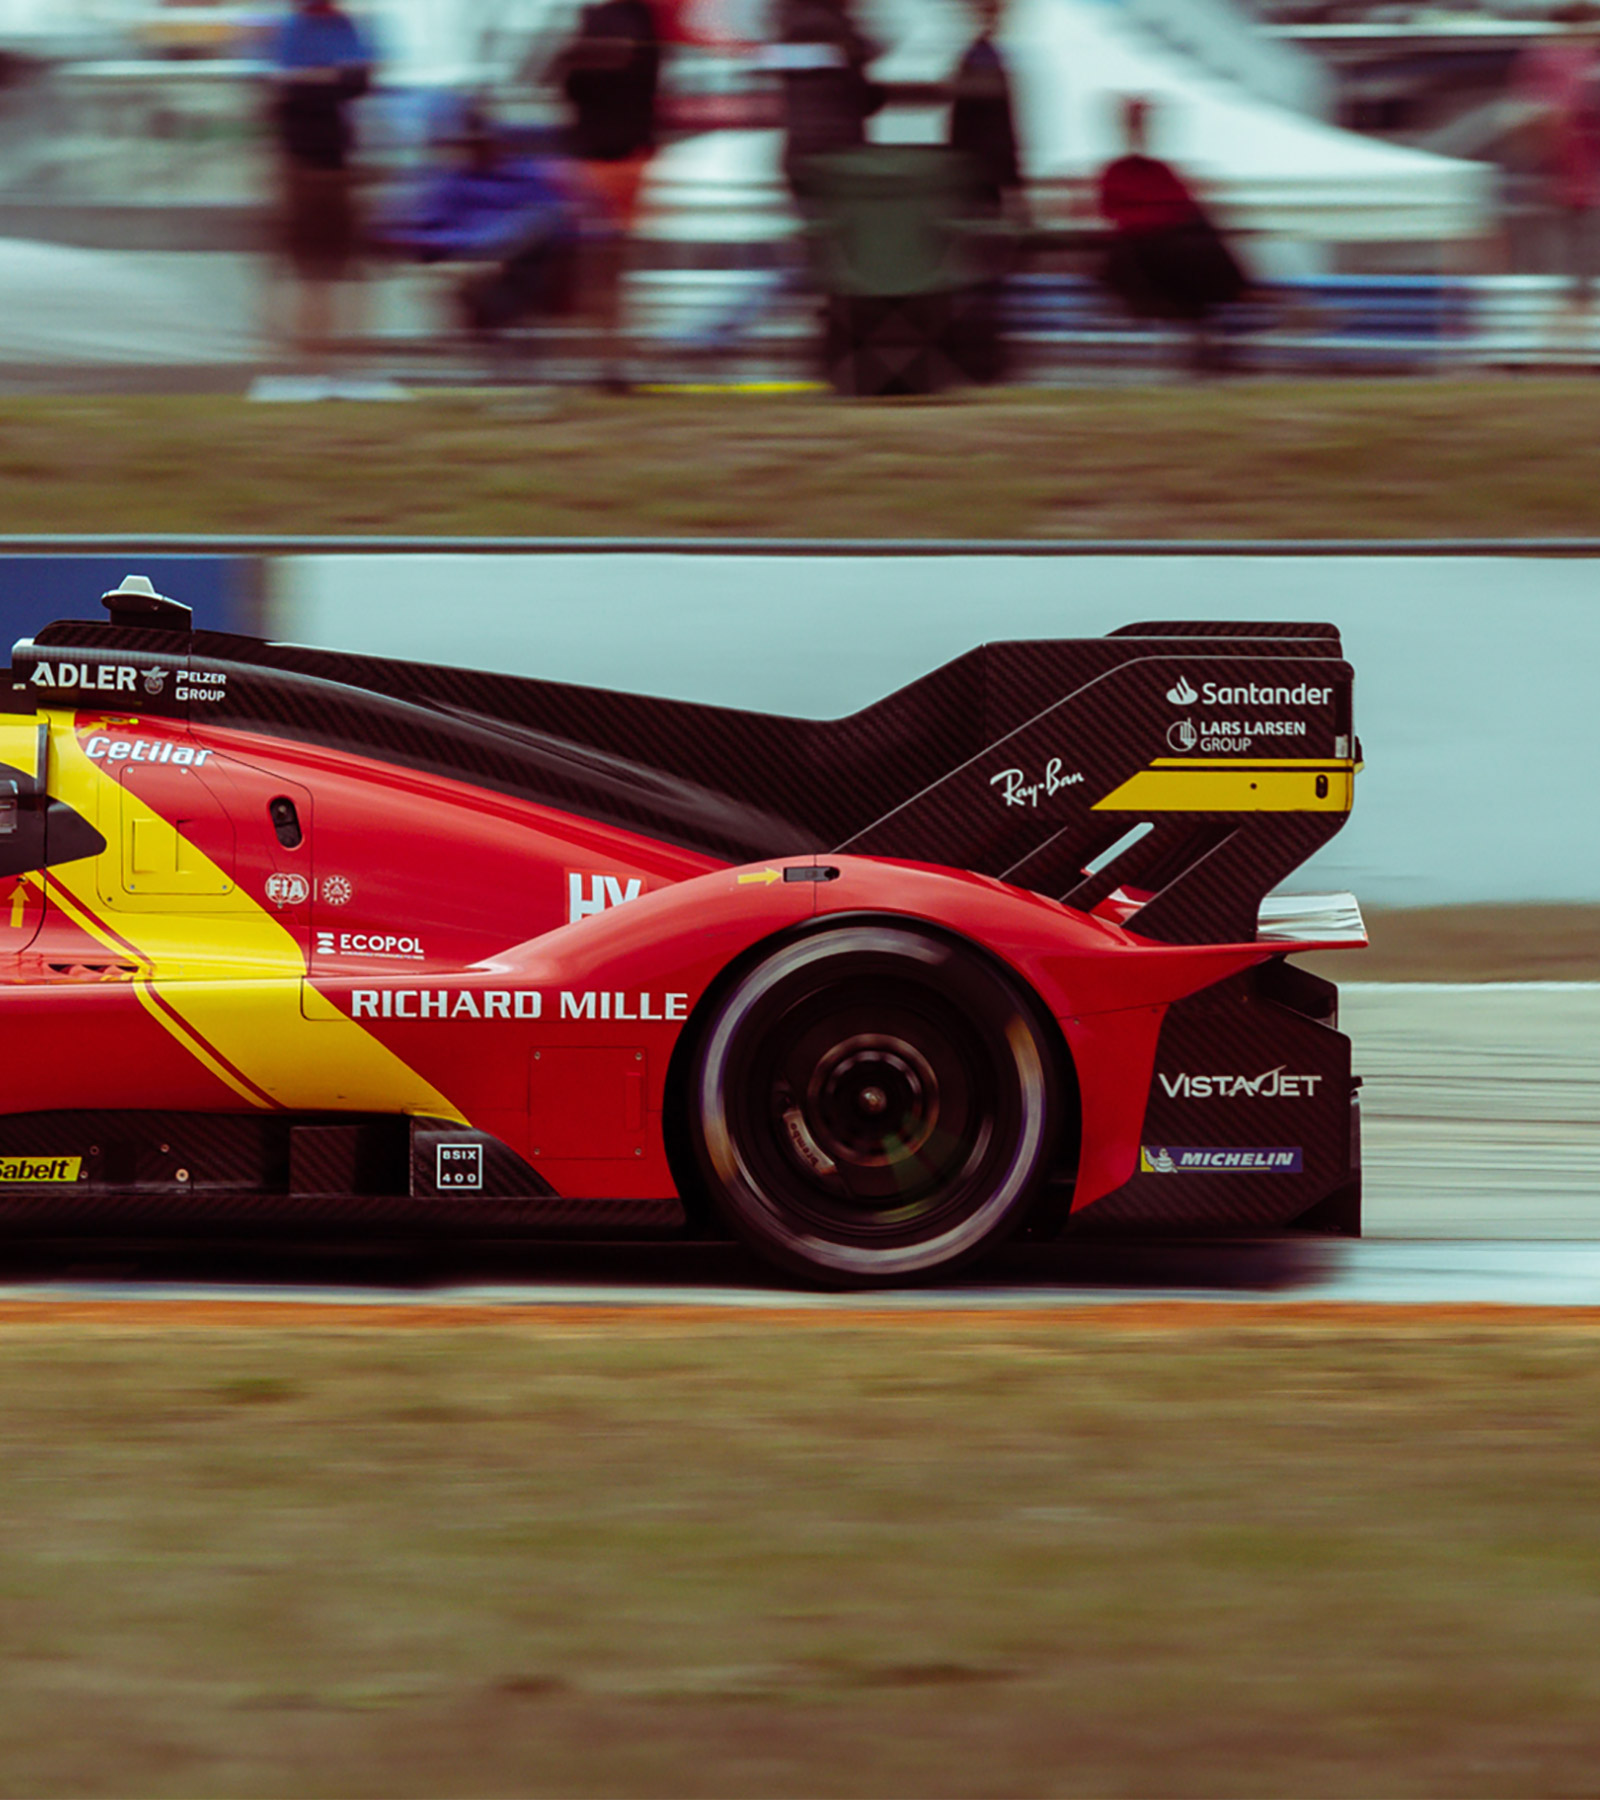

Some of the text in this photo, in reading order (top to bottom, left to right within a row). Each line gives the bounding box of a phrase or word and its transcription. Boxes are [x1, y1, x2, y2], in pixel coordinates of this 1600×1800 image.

[30, 662, 137, 691] ADLER
[176, 670, 226, 685] PELZER
[176, 687, 226, 701] GROUP
[1202, 682, 1333, 705] Santander
[1201, 721, 1306, 736] LARS LARSEN
[85, 736, 214, 766] Cetilar
[1201, 737, 1252, 752] GROUP
[990, 757, 1084, 807] Ray-Ban
[269, 880, 304, 897] FIA
[340, 933, 424, 954] ECOPOL
[351, 990, 689, 1021] RICHARD MILLE
[1180, 1152, 1294, 1167] MICHELIN
[442, 1173, 477, 1183] 400
